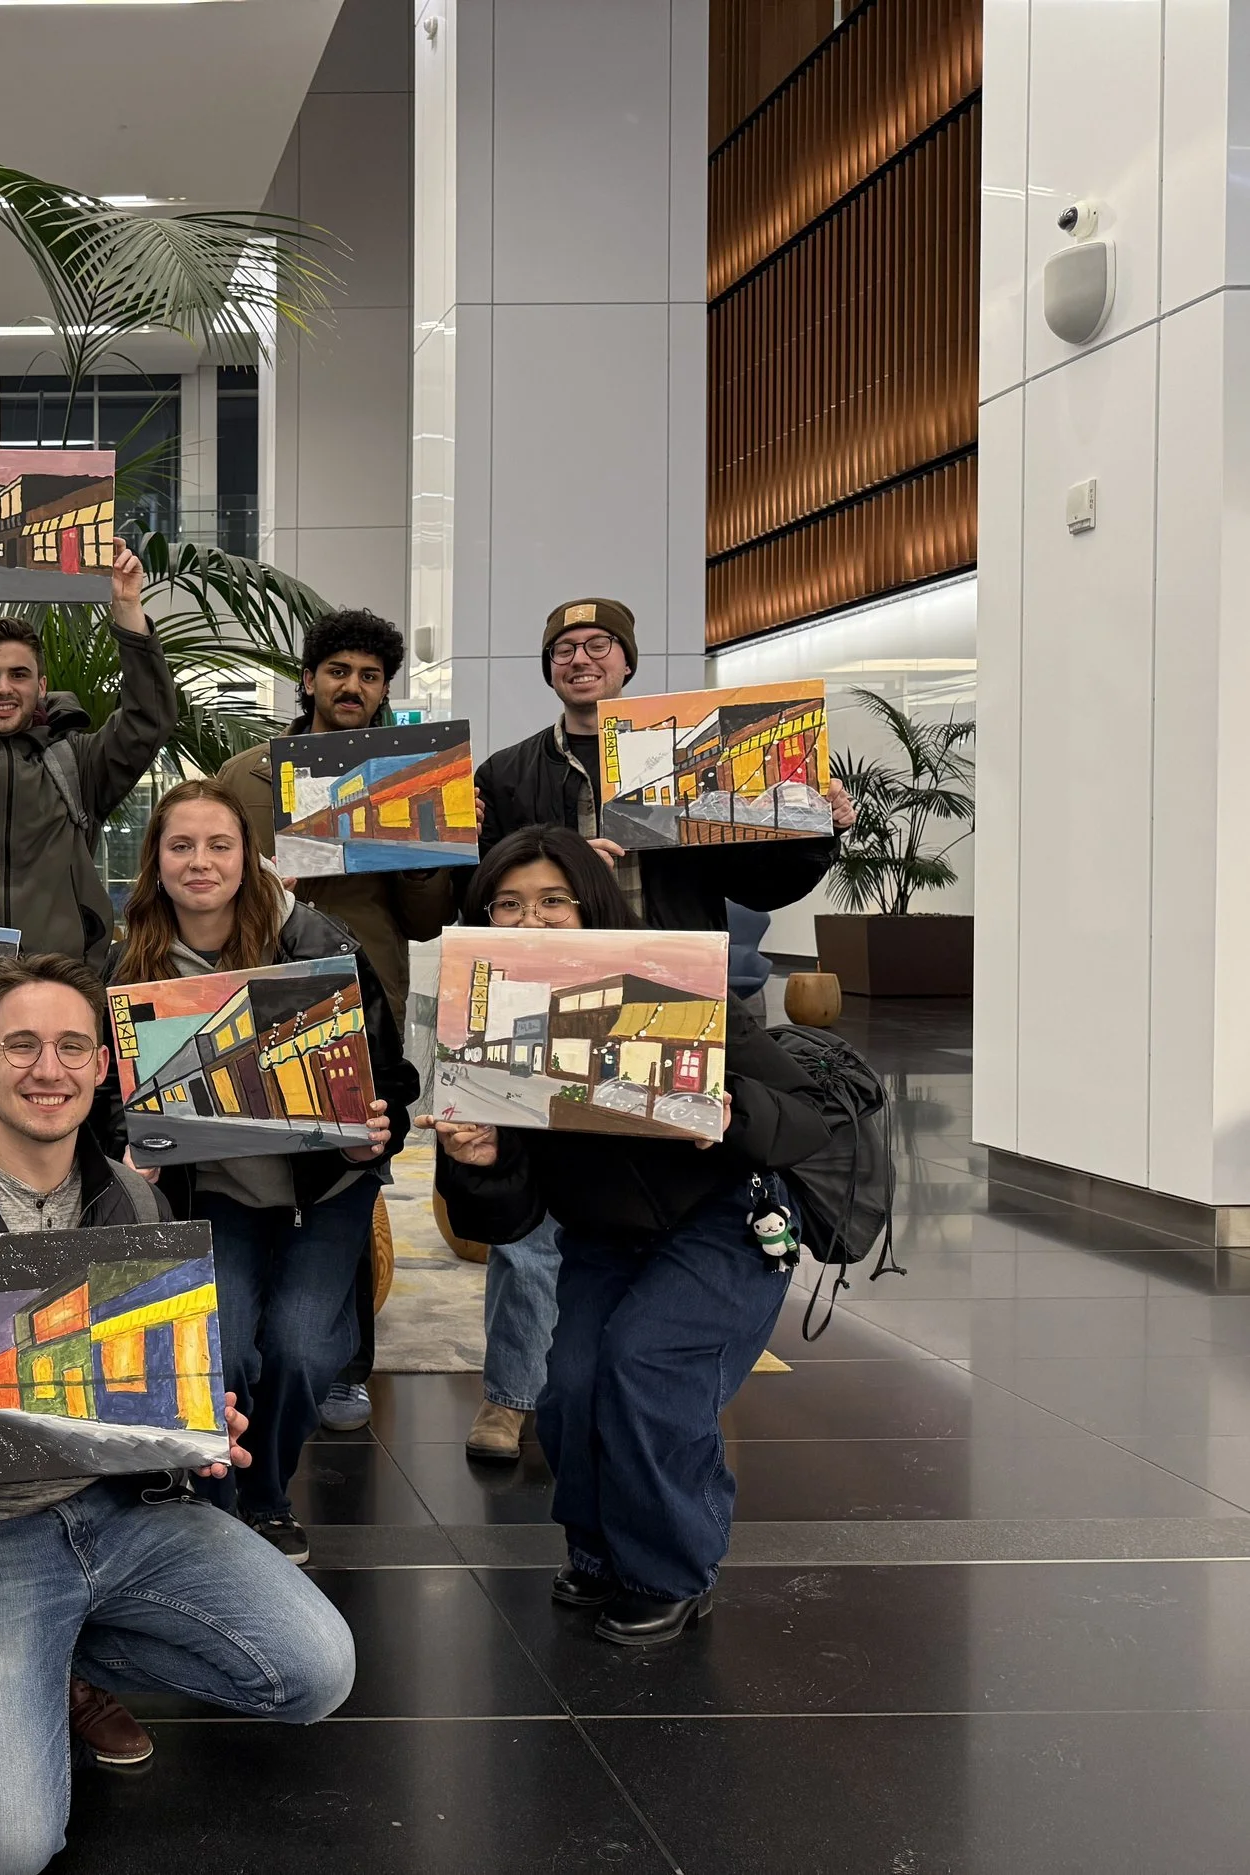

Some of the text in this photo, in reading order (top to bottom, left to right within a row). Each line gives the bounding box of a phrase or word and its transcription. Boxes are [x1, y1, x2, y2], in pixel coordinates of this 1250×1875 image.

[606, 720, 615, 757] ROXY
[475, 963, 486, 1015] ROXY
[114, 998, 131, 1048] ROXY
